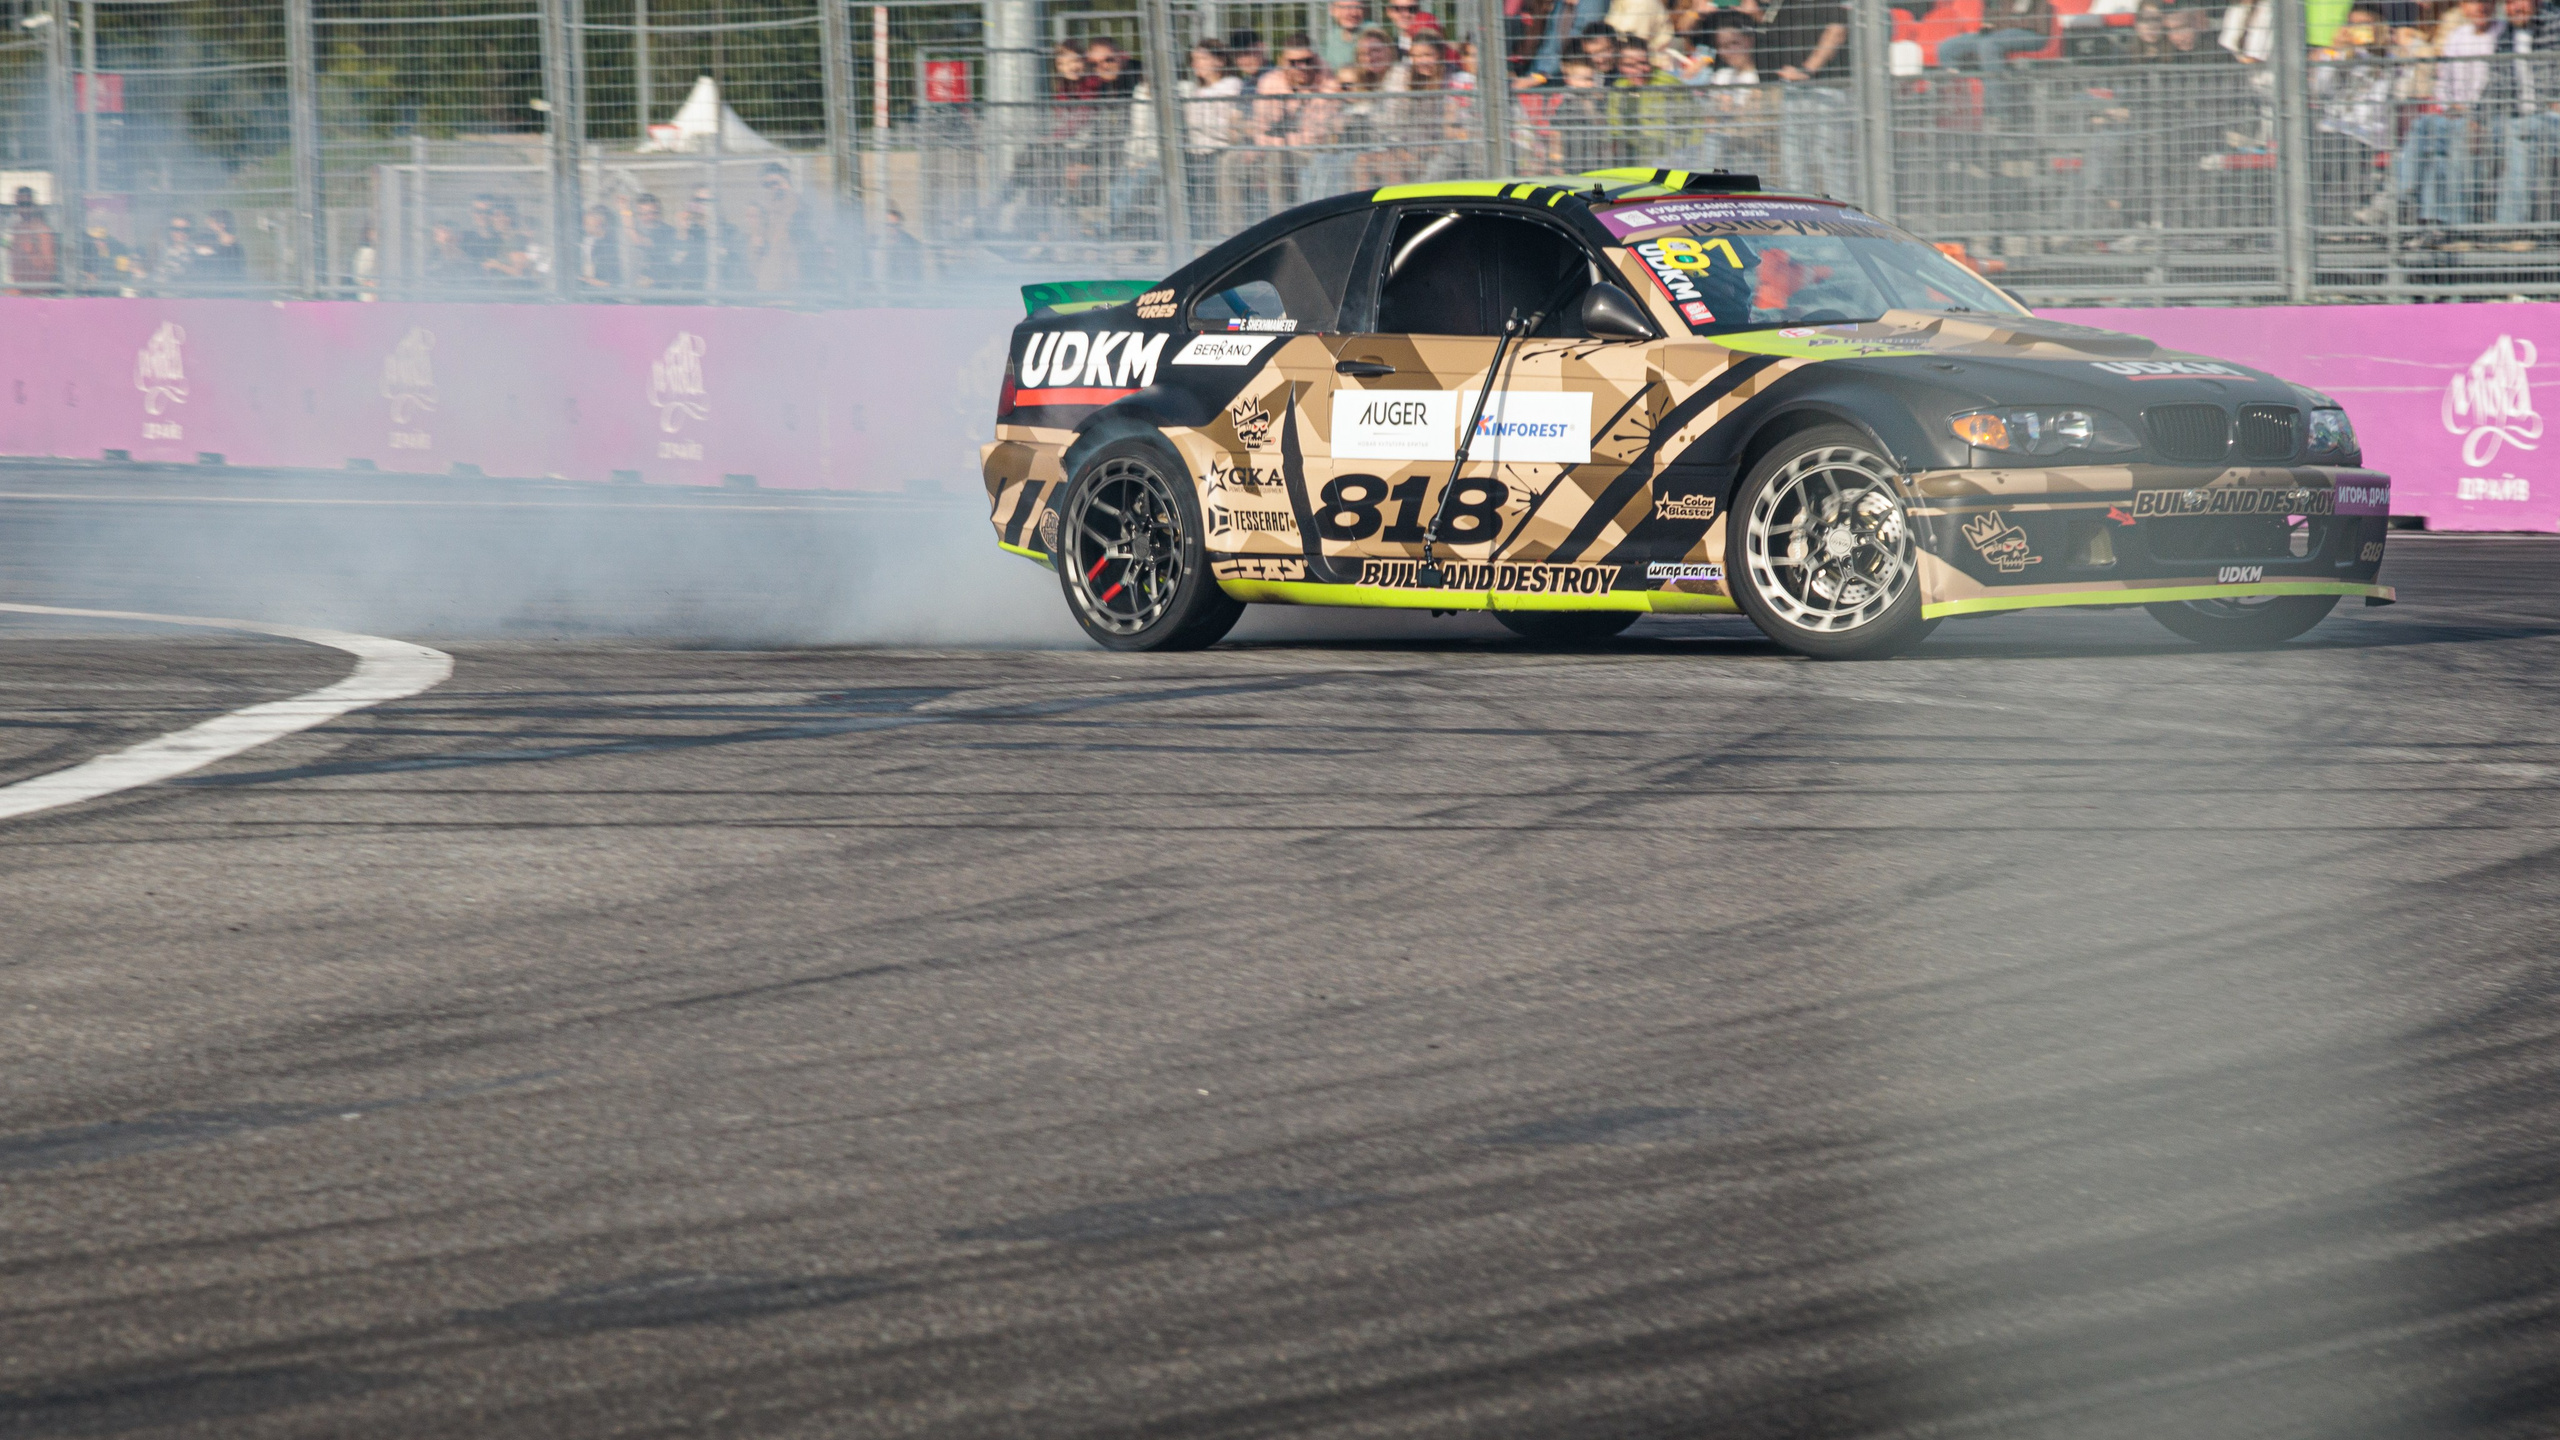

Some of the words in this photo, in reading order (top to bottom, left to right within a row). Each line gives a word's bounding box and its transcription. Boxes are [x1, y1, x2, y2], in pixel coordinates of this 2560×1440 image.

[1637, 243, 1702, 301] UDKM
[1136, 288, 1175, 306] YOYO
[1137, 303, 1178, 319] TIRES
[1021, 331, 1170, 388] UDKM
[2089, 361, 2246, 376] UDKM
[1359, 401, 1428, 426] AUGER
[1476, 415, 1568, 438] KINFOREST
[1229, 467, 1284, 486] GKA
[1684, 496, 1714, 507] Color
[2208, 489, 2257, 516] AND
[2338, 486, 2368, 504] ИГОРА
[1313, 473, 1510, 546] 818
[1668, 505, 1713, 517] Blaster
[1234, 510, 1290, 533] TESSERACT
[2360, 541, 2384, 562] 818
[1357, 559, 1439, 589] BUIL
[1442, 561, 1494, 592] AND
[1494, 562, 1620, 595] DESTROY
[2218, 565, 2263, 583] UDKM
